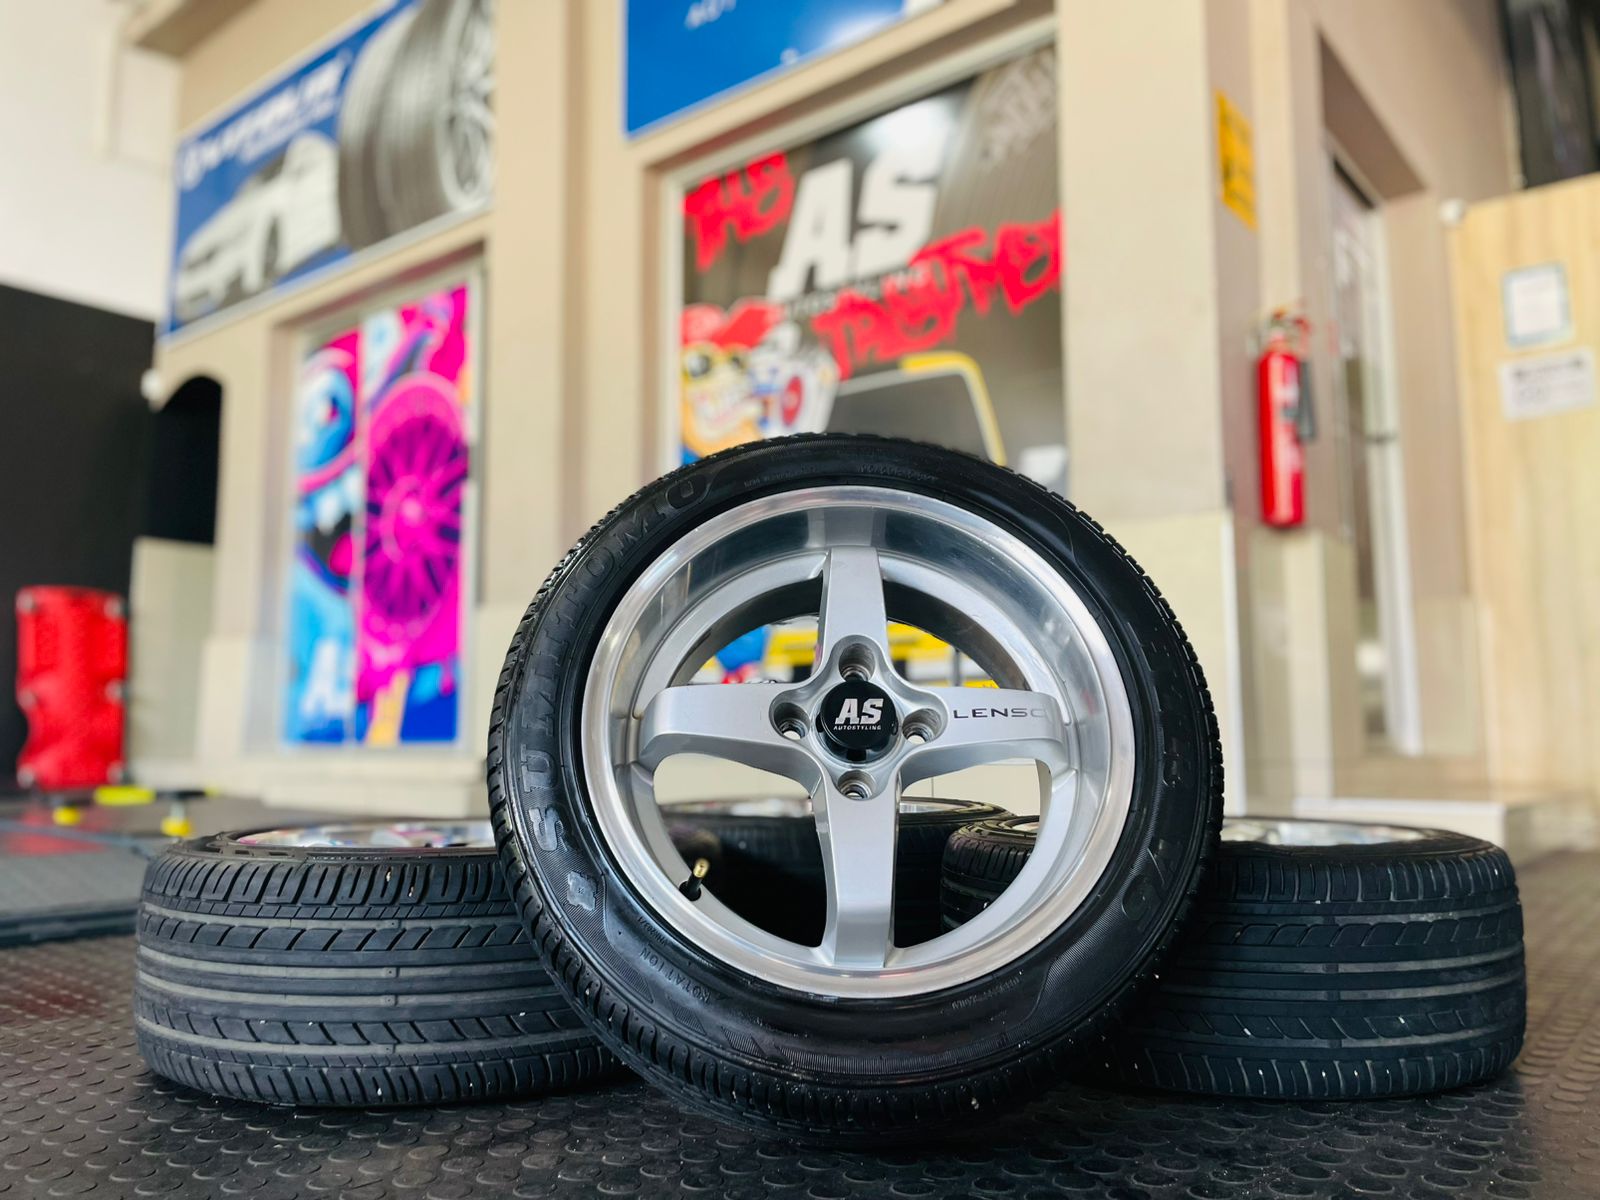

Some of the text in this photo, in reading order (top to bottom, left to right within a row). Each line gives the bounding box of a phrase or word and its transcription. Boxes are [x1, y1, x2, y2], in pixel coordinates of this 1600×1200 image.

[768, 147, 944, 301] AS
[519, 473, 709, 852] SUMITOMO
[834, 698, 884, 725] AS
[641, 947, 711, 1004] ROTATION
